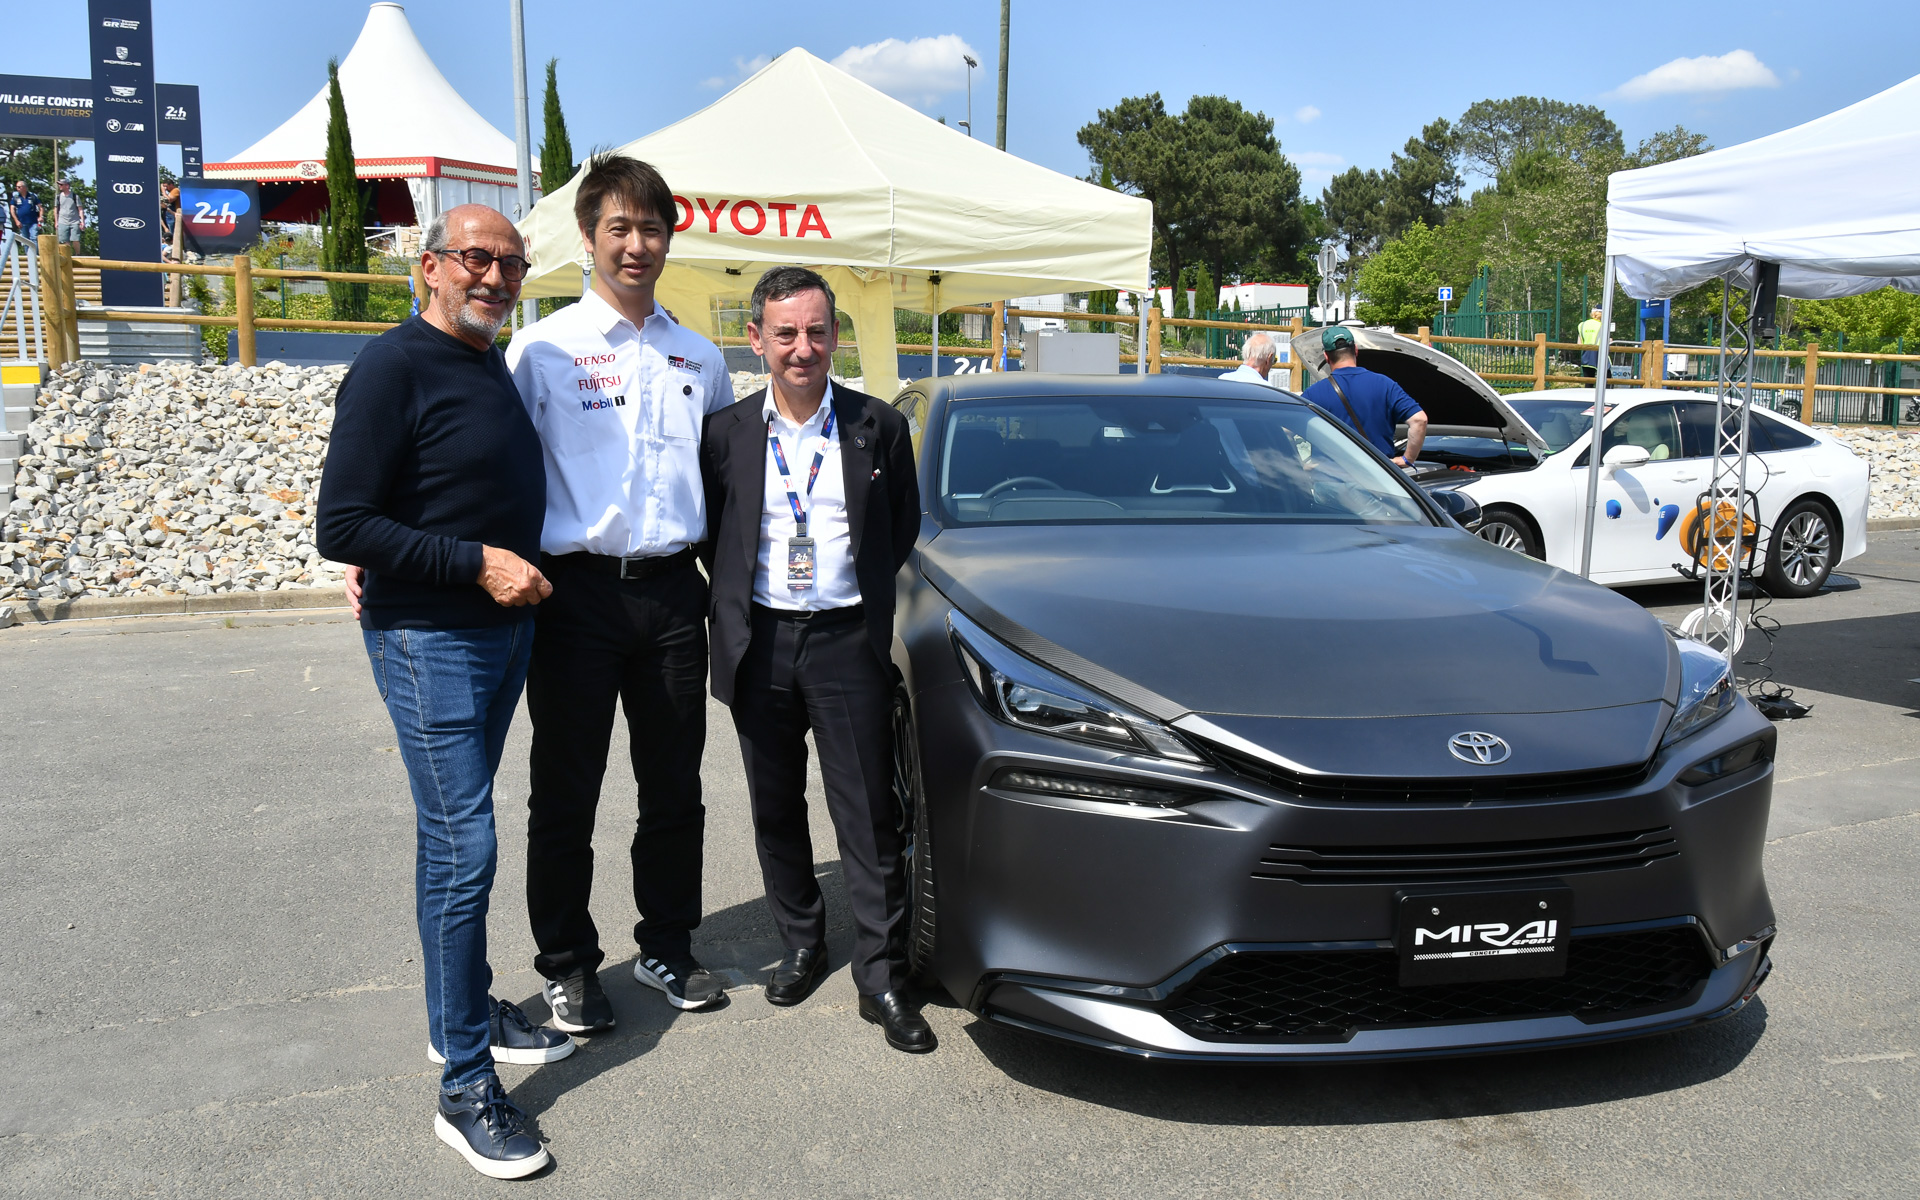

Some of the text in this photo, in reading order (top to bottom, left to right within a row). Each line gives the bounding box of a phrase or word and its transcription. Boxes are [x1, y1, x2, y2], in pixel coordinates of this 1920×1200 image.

[103, 20, 120, 28] GR
[104, 96, 144, 105] CADILLAC
[165, 105, 187, 118] 24h
[192, 201, 237, 224] 24h
[673, 194, 832, 239] OYOTA
[118, 219, 140, 228] Ford
[574, 353, 616, 367] DENSO
[578, 371, 622, 394] FUJITSU
[582, 395, 626, 412] Mobil 1
[1414, 919, 1558, 947] MIRAI
[1511, 937, 1556, 946] SPORT
